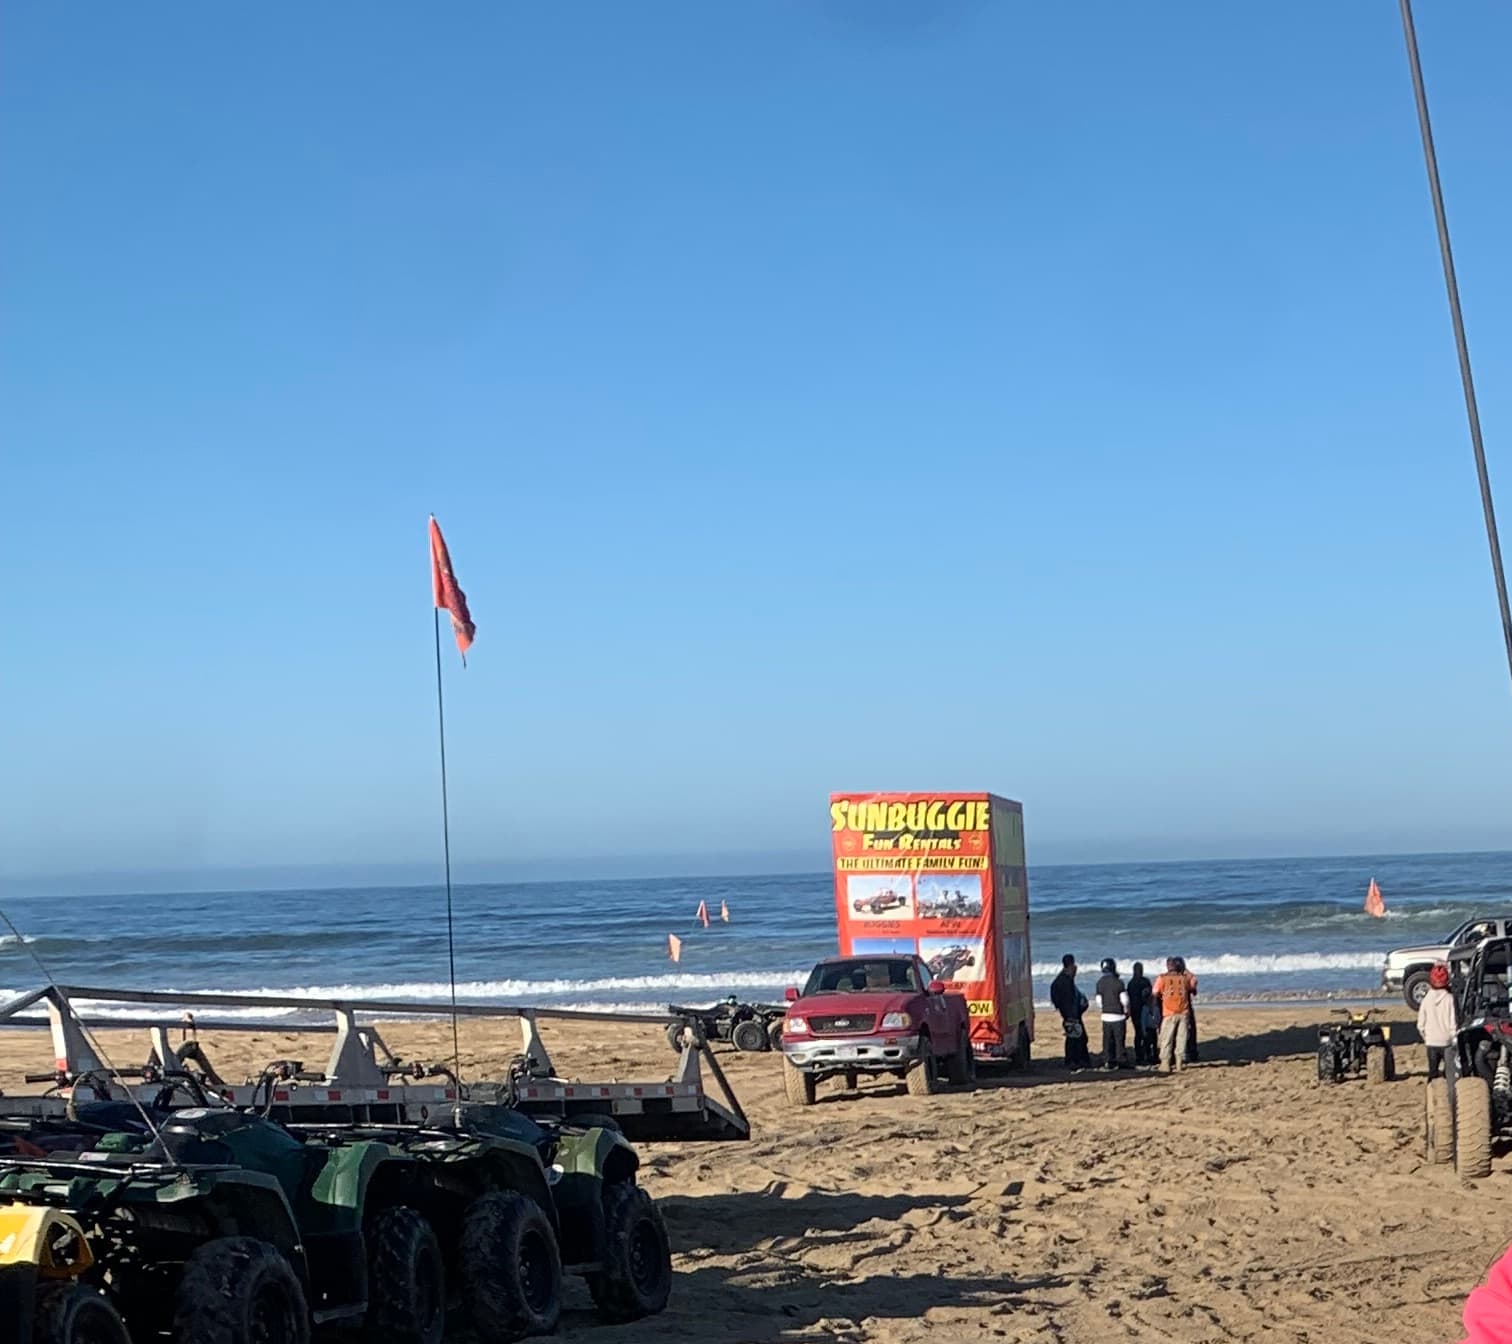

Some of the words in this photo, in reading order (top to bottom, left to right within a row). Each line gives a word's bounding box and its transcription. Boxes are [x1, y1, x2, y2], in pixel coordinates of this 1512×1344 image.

[830, 800, 990, 831] SUNBUGGIE
[840, 858, 859, 869] THE
[861, 858, 913, 869] ULTIMATE
[917, 858, 955, 869] FAMILY
[958, 857, 985, 868] FUN!
[967, 1003, 990, 1014] OW
